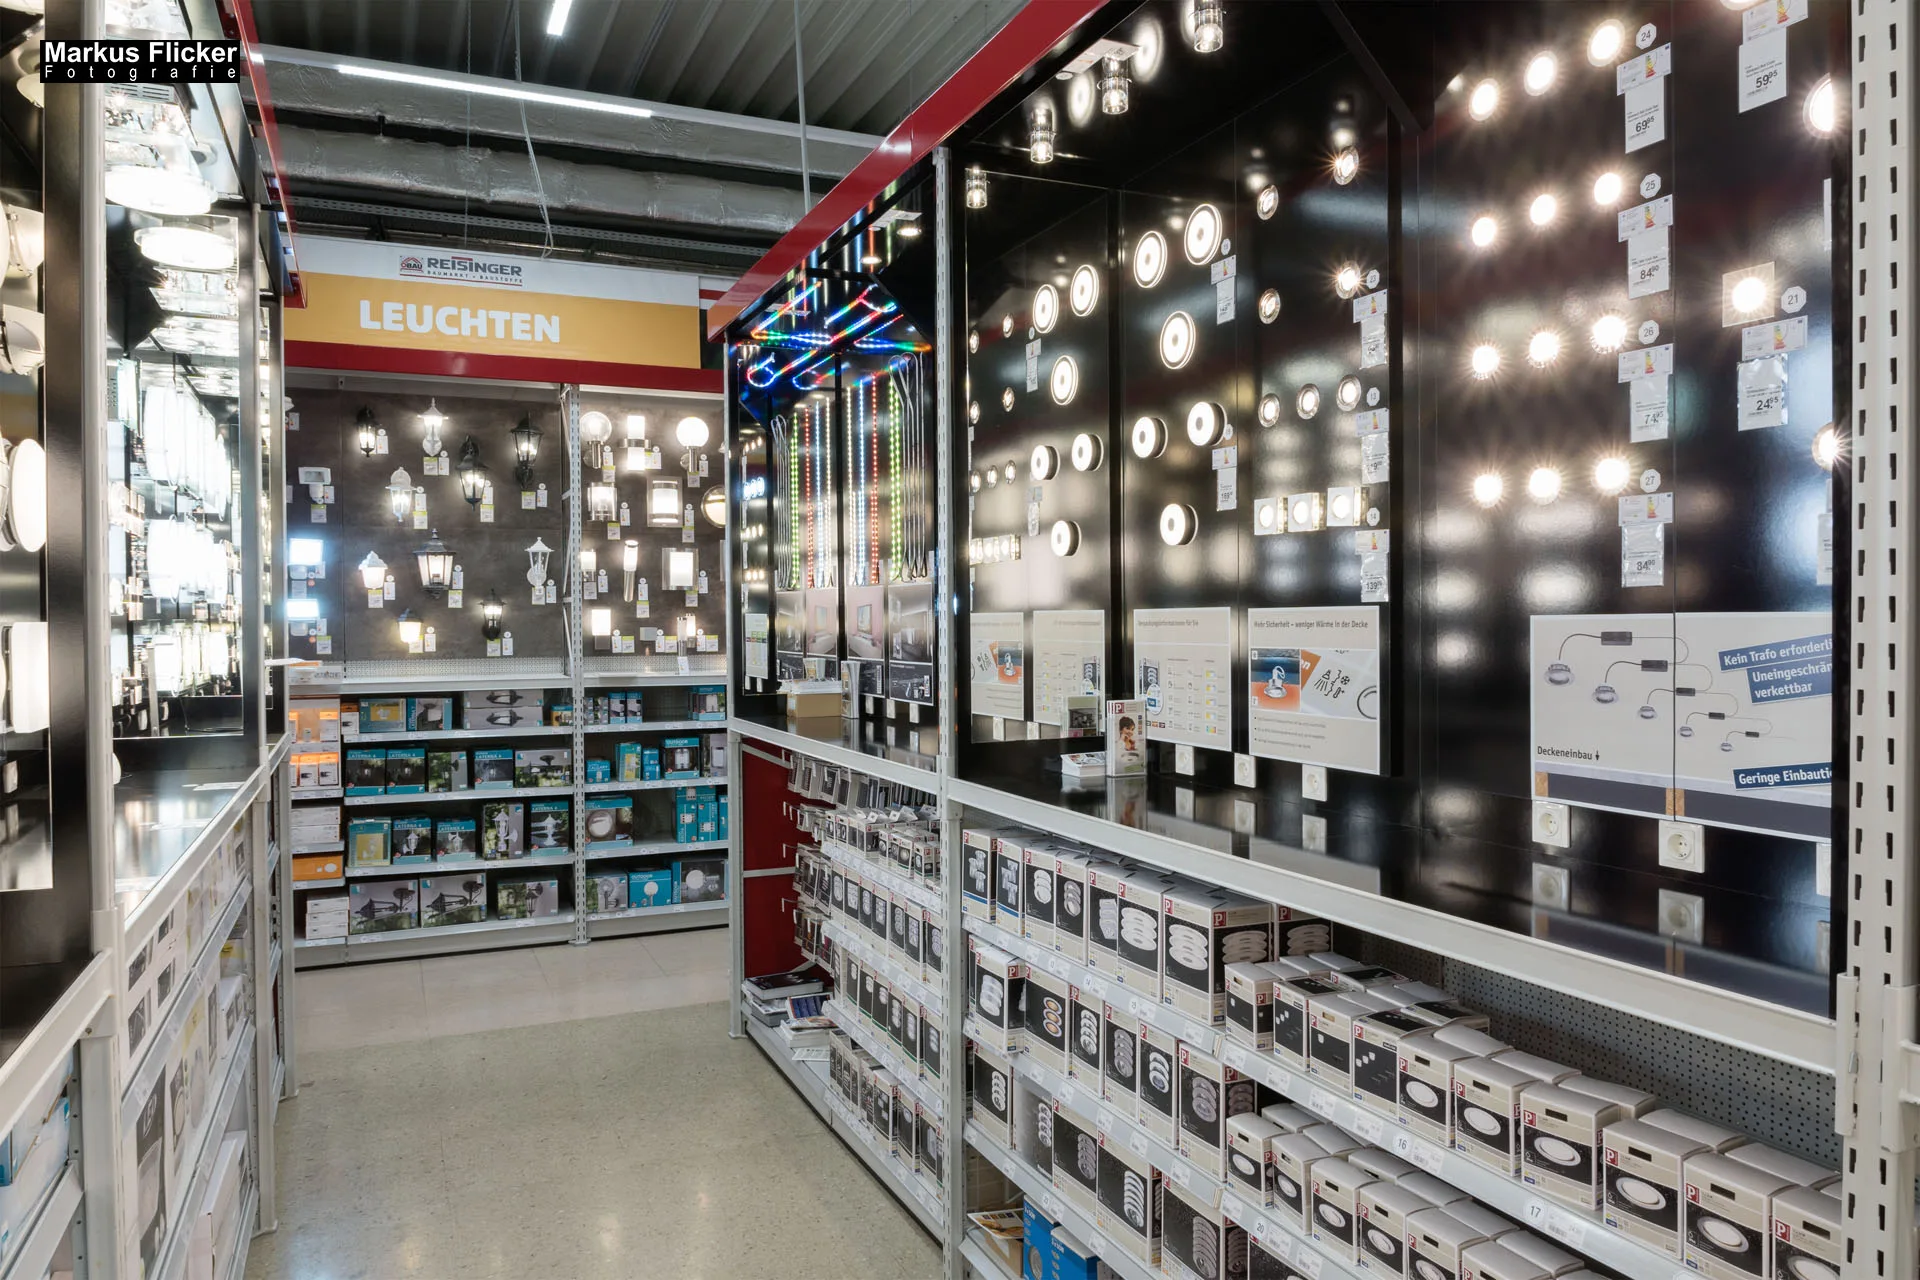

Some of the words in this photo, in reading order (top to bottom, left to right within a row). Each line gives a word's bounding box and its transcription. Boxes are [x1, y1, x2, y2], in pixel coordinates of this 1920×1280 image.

[1641, 30, 1651, 41] 24
[1646, 180, 1655, 191] 25
[427, 258, 522, 277] REISINGER
[427, 271, 468, 279] BAUMARKT
[1788, 295, 1798, 305] 21
[360, 300, 560, 343] LEUCHTEN
[1644, 327, 1654, 337] 26
[1645, 476, 1655, 486] 27
[1351, 620, 1369, 628] Decke
[1724, 653, 1748, 666] Kein
[1749, 648, 1777, 663] Trafo
[1755, 682, 1813, 699] verkettbar
[1537, 746, 1593, 761] Deckeneinbau
[1738, 772, 1781, 785] Geringe
[1398, 1139, 1407, 1150] 16
[1530, 1205, 1541, 1218] 17
[1256, 1223, 1264, 1234] 20
